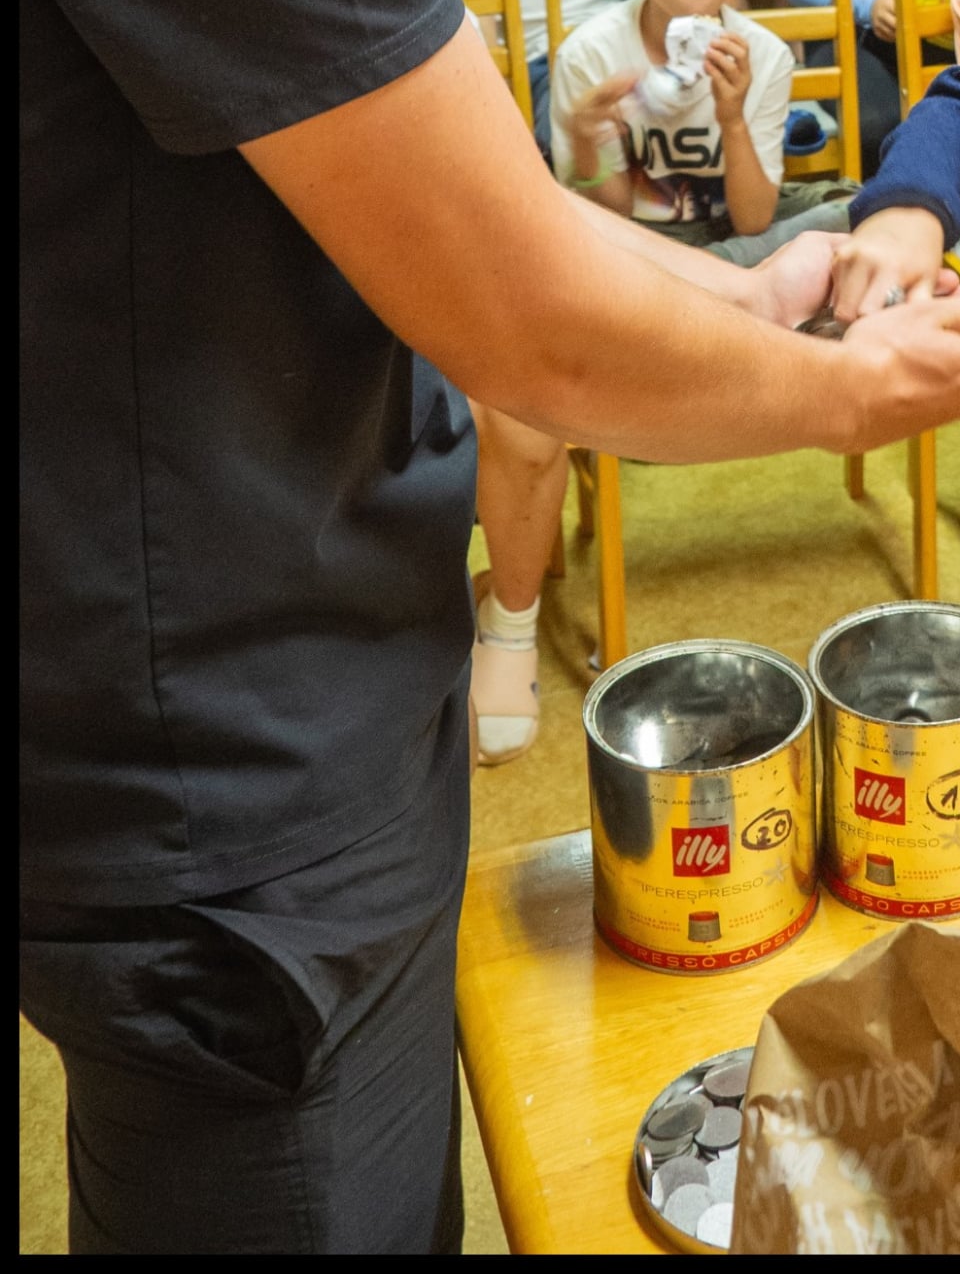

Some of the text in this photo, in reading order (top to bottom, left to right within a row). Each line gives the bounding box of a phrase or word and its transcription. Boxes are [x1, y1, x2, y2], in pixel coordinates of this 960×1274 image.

[857, 778, 903, 819] illy
[675, 834, 727, 874] illy
[641, 876, 765, 900] IPERESPRESSO
